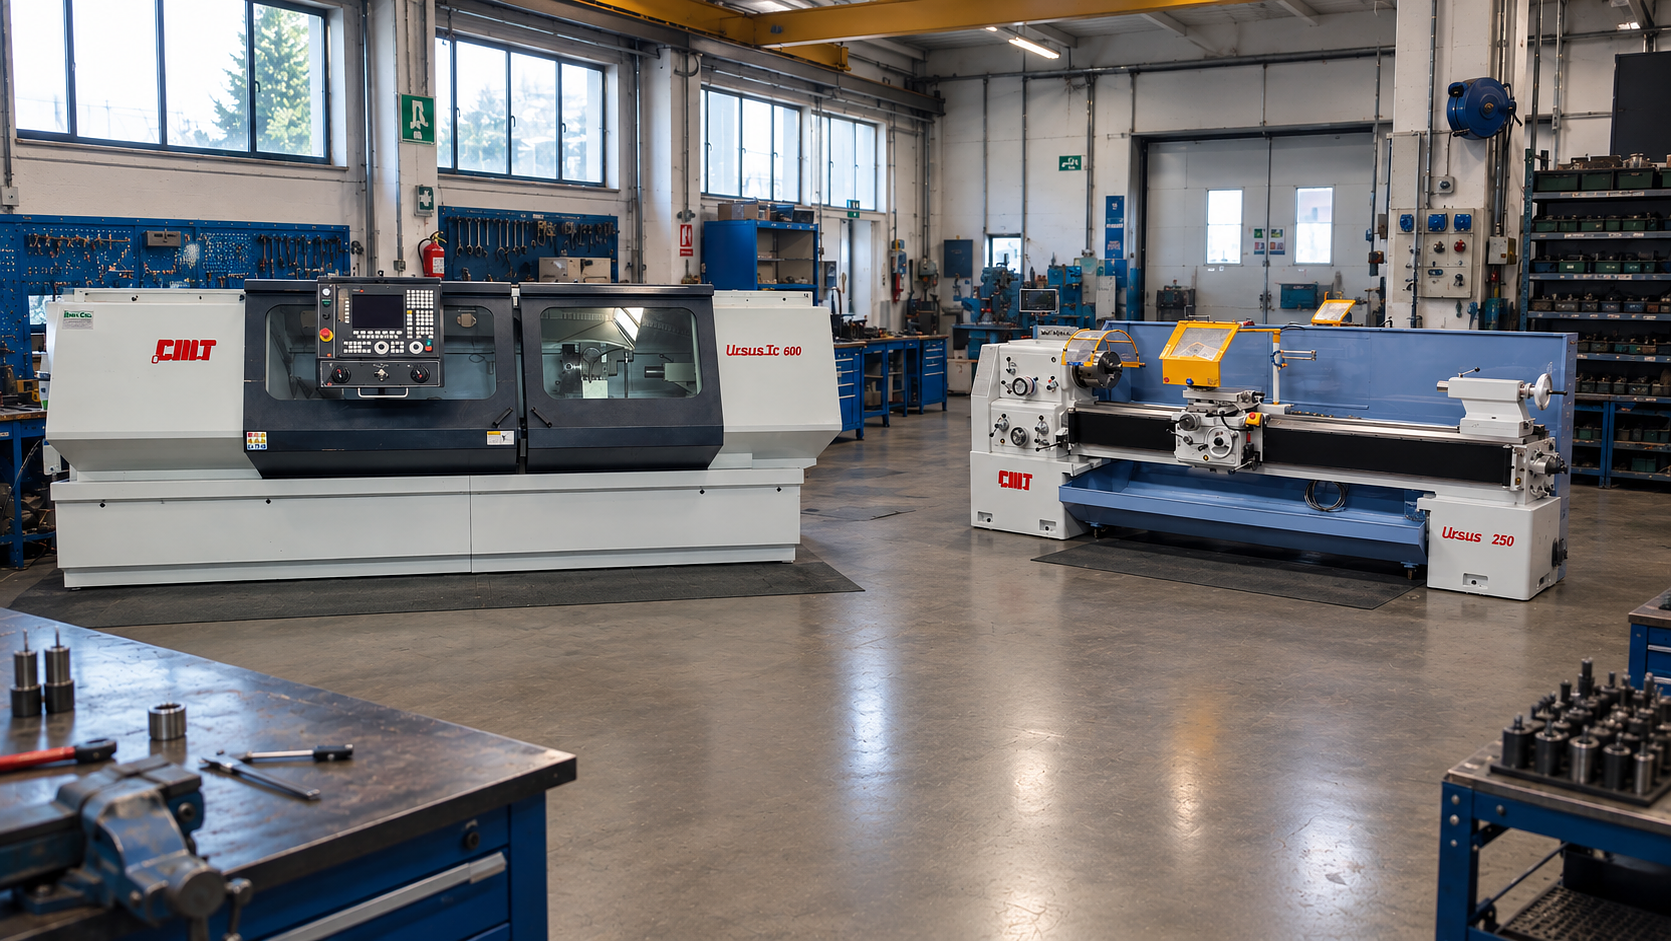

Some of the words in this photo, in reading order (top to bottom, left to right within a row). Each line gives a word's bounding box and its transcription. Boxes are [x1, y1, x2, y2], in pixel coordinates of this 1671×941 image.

[726, 344, 764, 356] Ursus
[783, 346, 802, 356] 600
[1442, 526, 1482, 543] Ursus
[1491, 534, 1515, 547] 250
